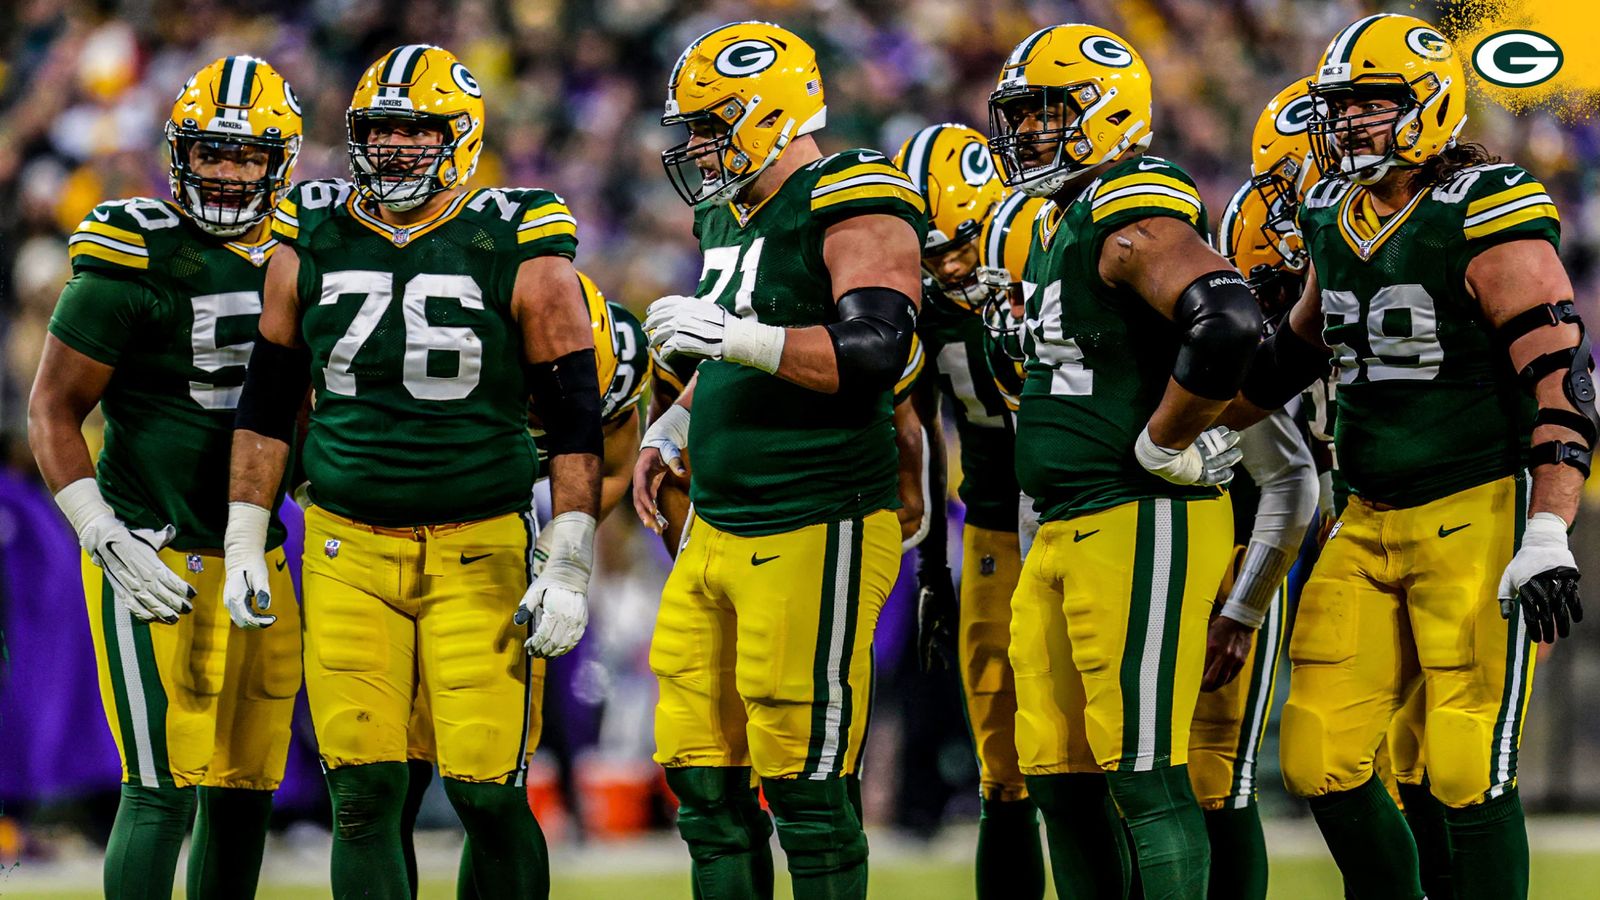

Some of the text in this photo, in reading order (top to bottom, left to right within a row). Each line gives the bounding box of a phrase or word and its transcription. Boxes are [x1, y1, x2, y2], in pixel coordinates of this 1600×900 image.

[714, 39, 777, 78] G
[1079, 35, 1133, 68] G
[451, 62, 482, 98] G
[378, 99, 402, 107] PACKERS
[217, 120, 242, 130] PACKERS
[961, 142, 996, 187] G
[698, 236, 766, 322] 71
[318, 270, 485, 401] 76
[1321, 284, 1444, 385] 69
